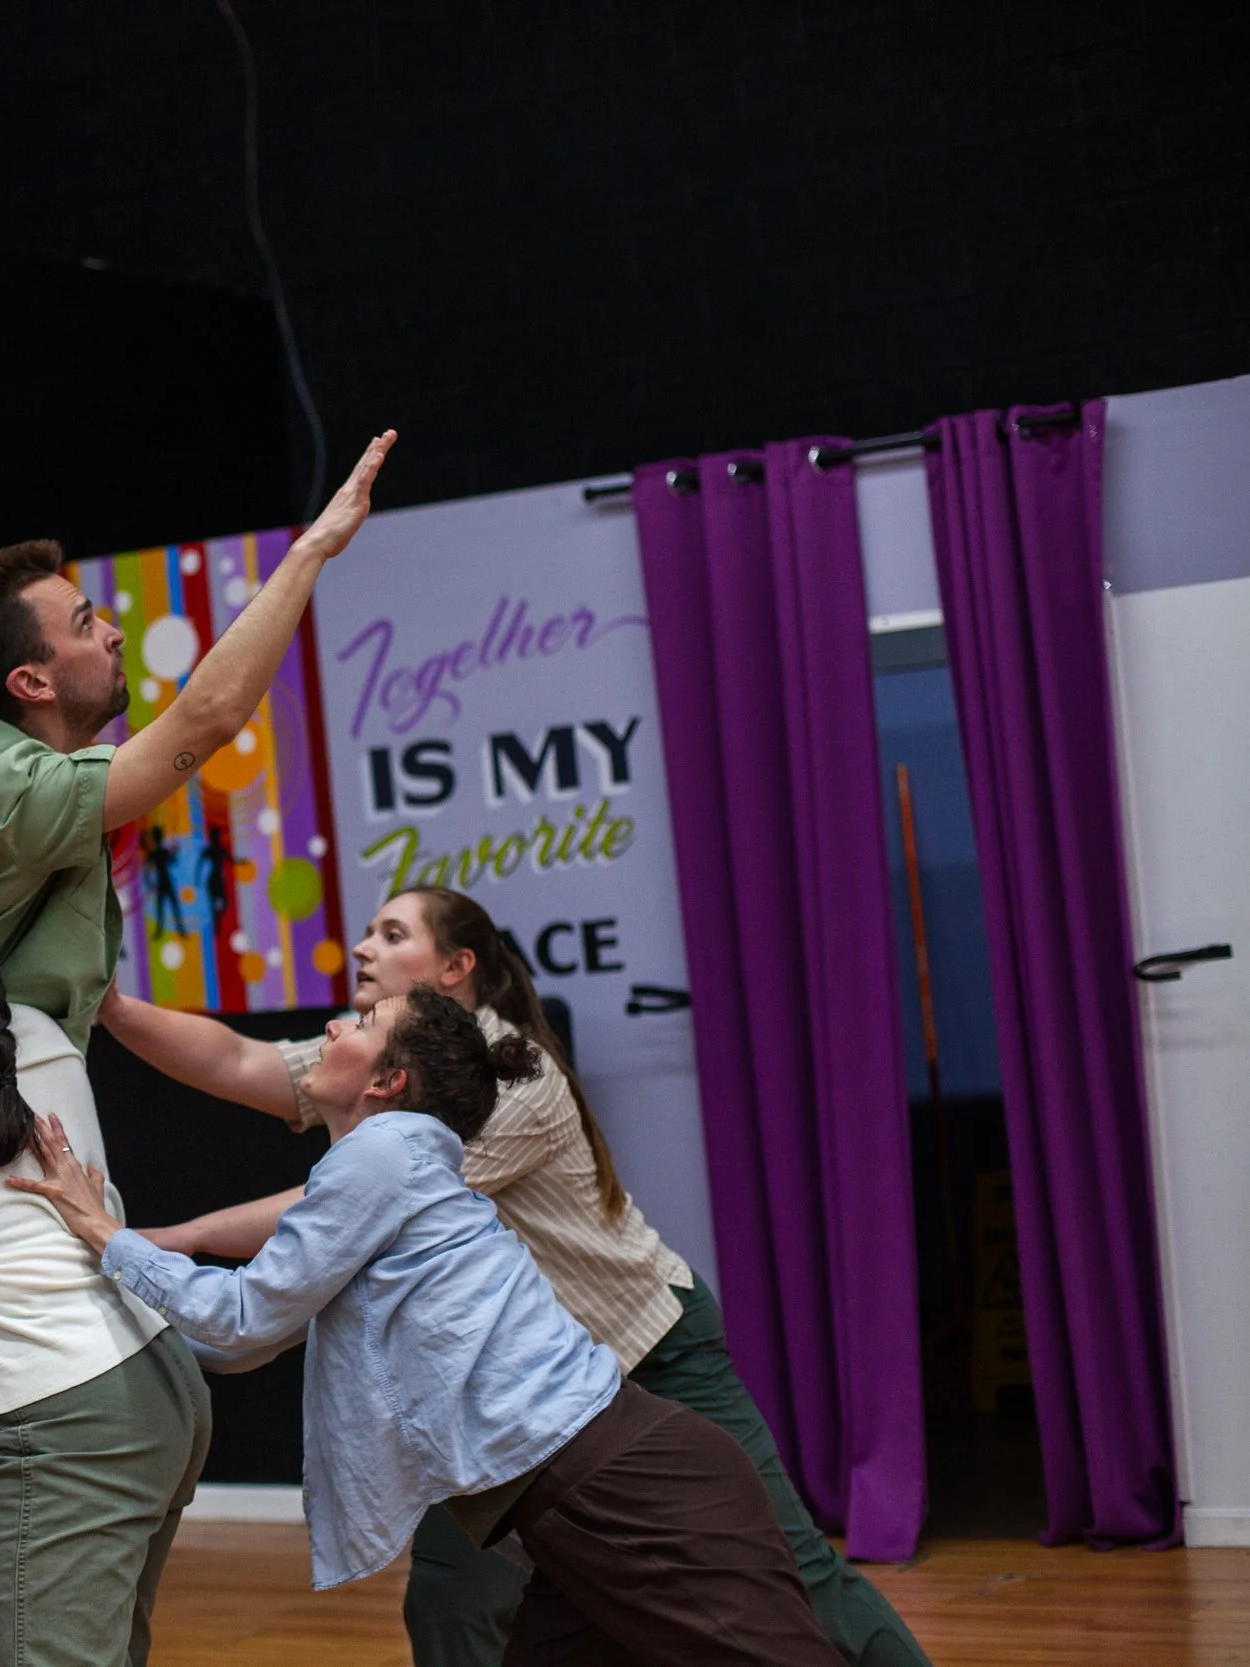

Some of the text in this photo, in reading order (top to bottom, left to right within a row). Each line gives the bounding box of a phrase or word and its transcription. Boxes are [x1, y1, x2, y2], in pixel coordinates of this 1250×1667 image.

[336, 596, 649, 739] Together
[366, 716, 641, 814] IS MY
[361, 797, 635, 900] Favorite
